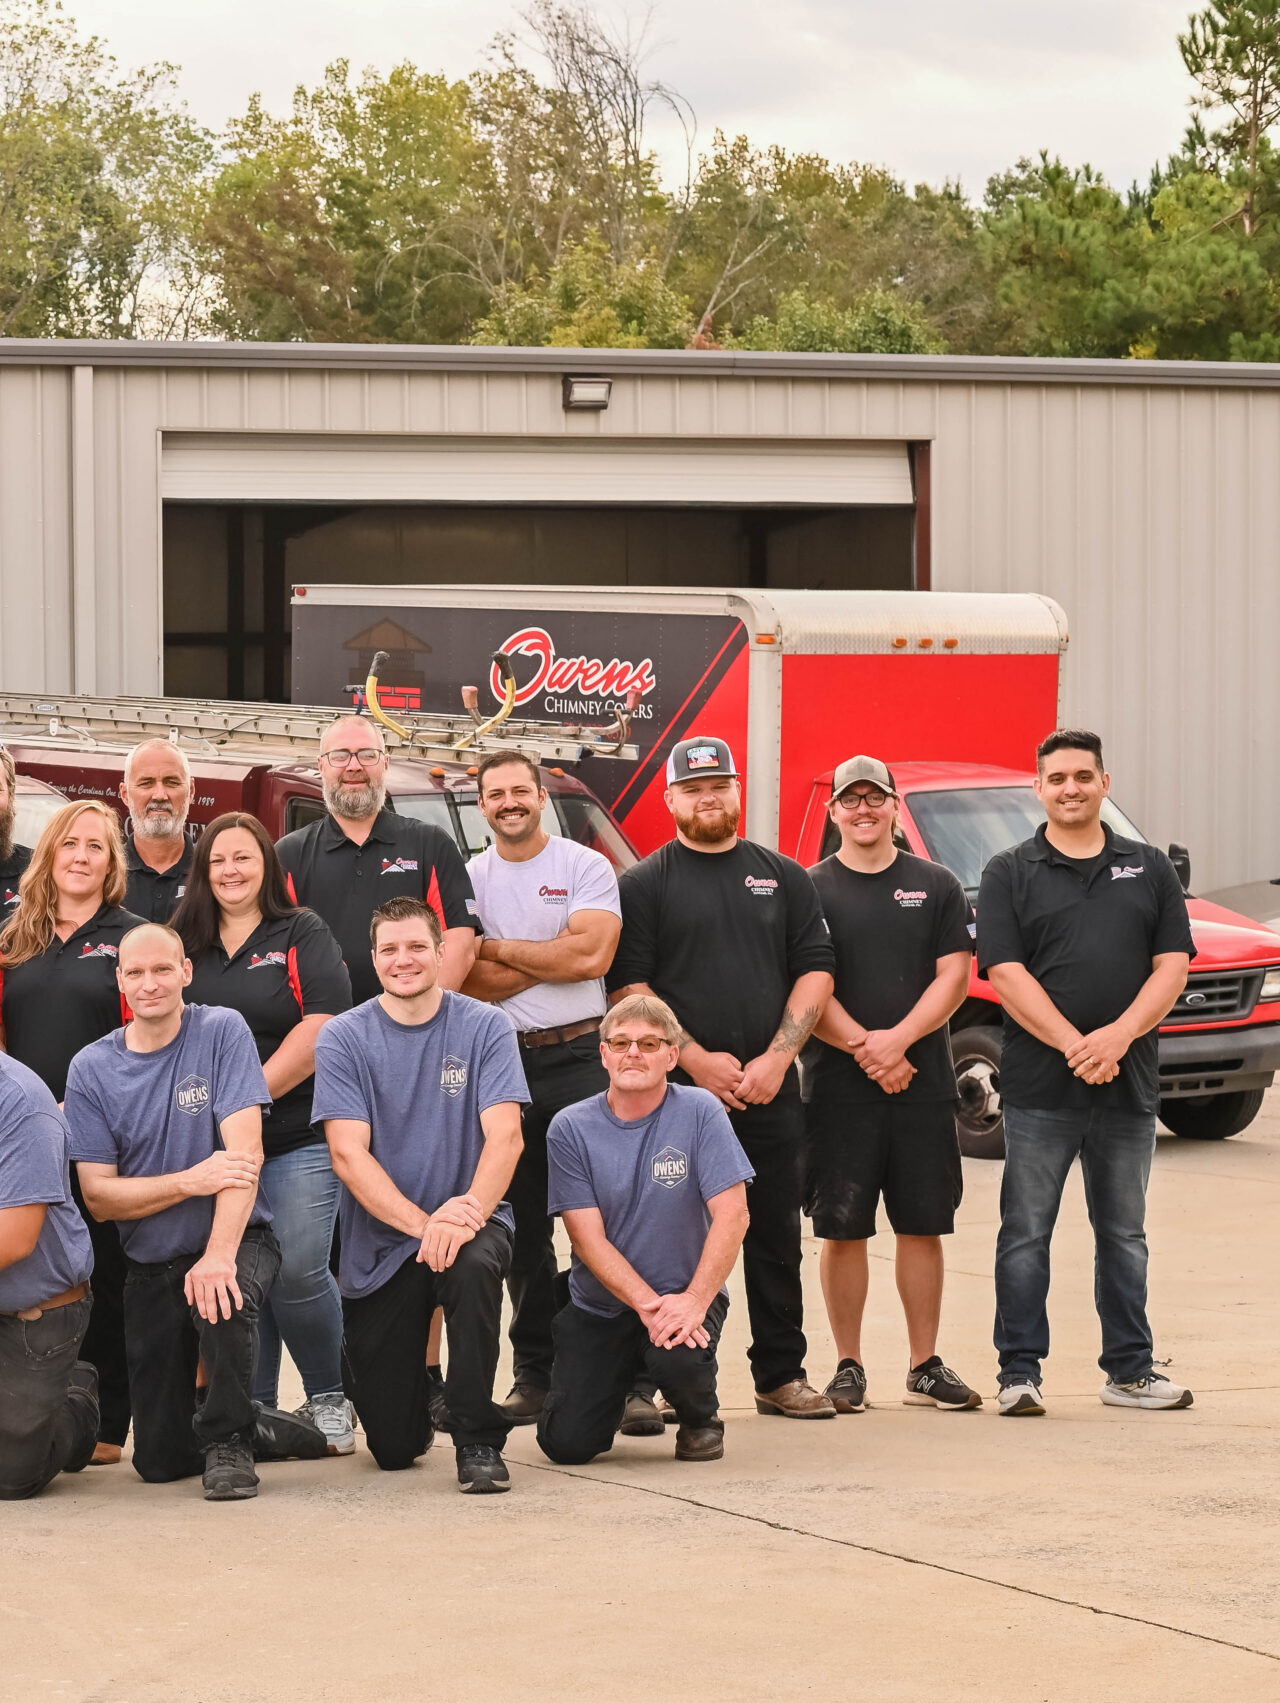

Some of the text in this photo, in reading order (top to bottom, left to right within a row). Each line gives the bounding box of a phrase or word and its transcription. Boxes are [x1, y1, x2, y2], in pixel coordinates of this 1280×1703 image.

[489, 626, 656, 707] Owens
[544, 696, 653, 719] CHIMNEY COERS
[894, 888, 927, 900] Owens
[179, 1086, 209, 1106] OWENS
[654, 1160, 686, 1177] OWENS
